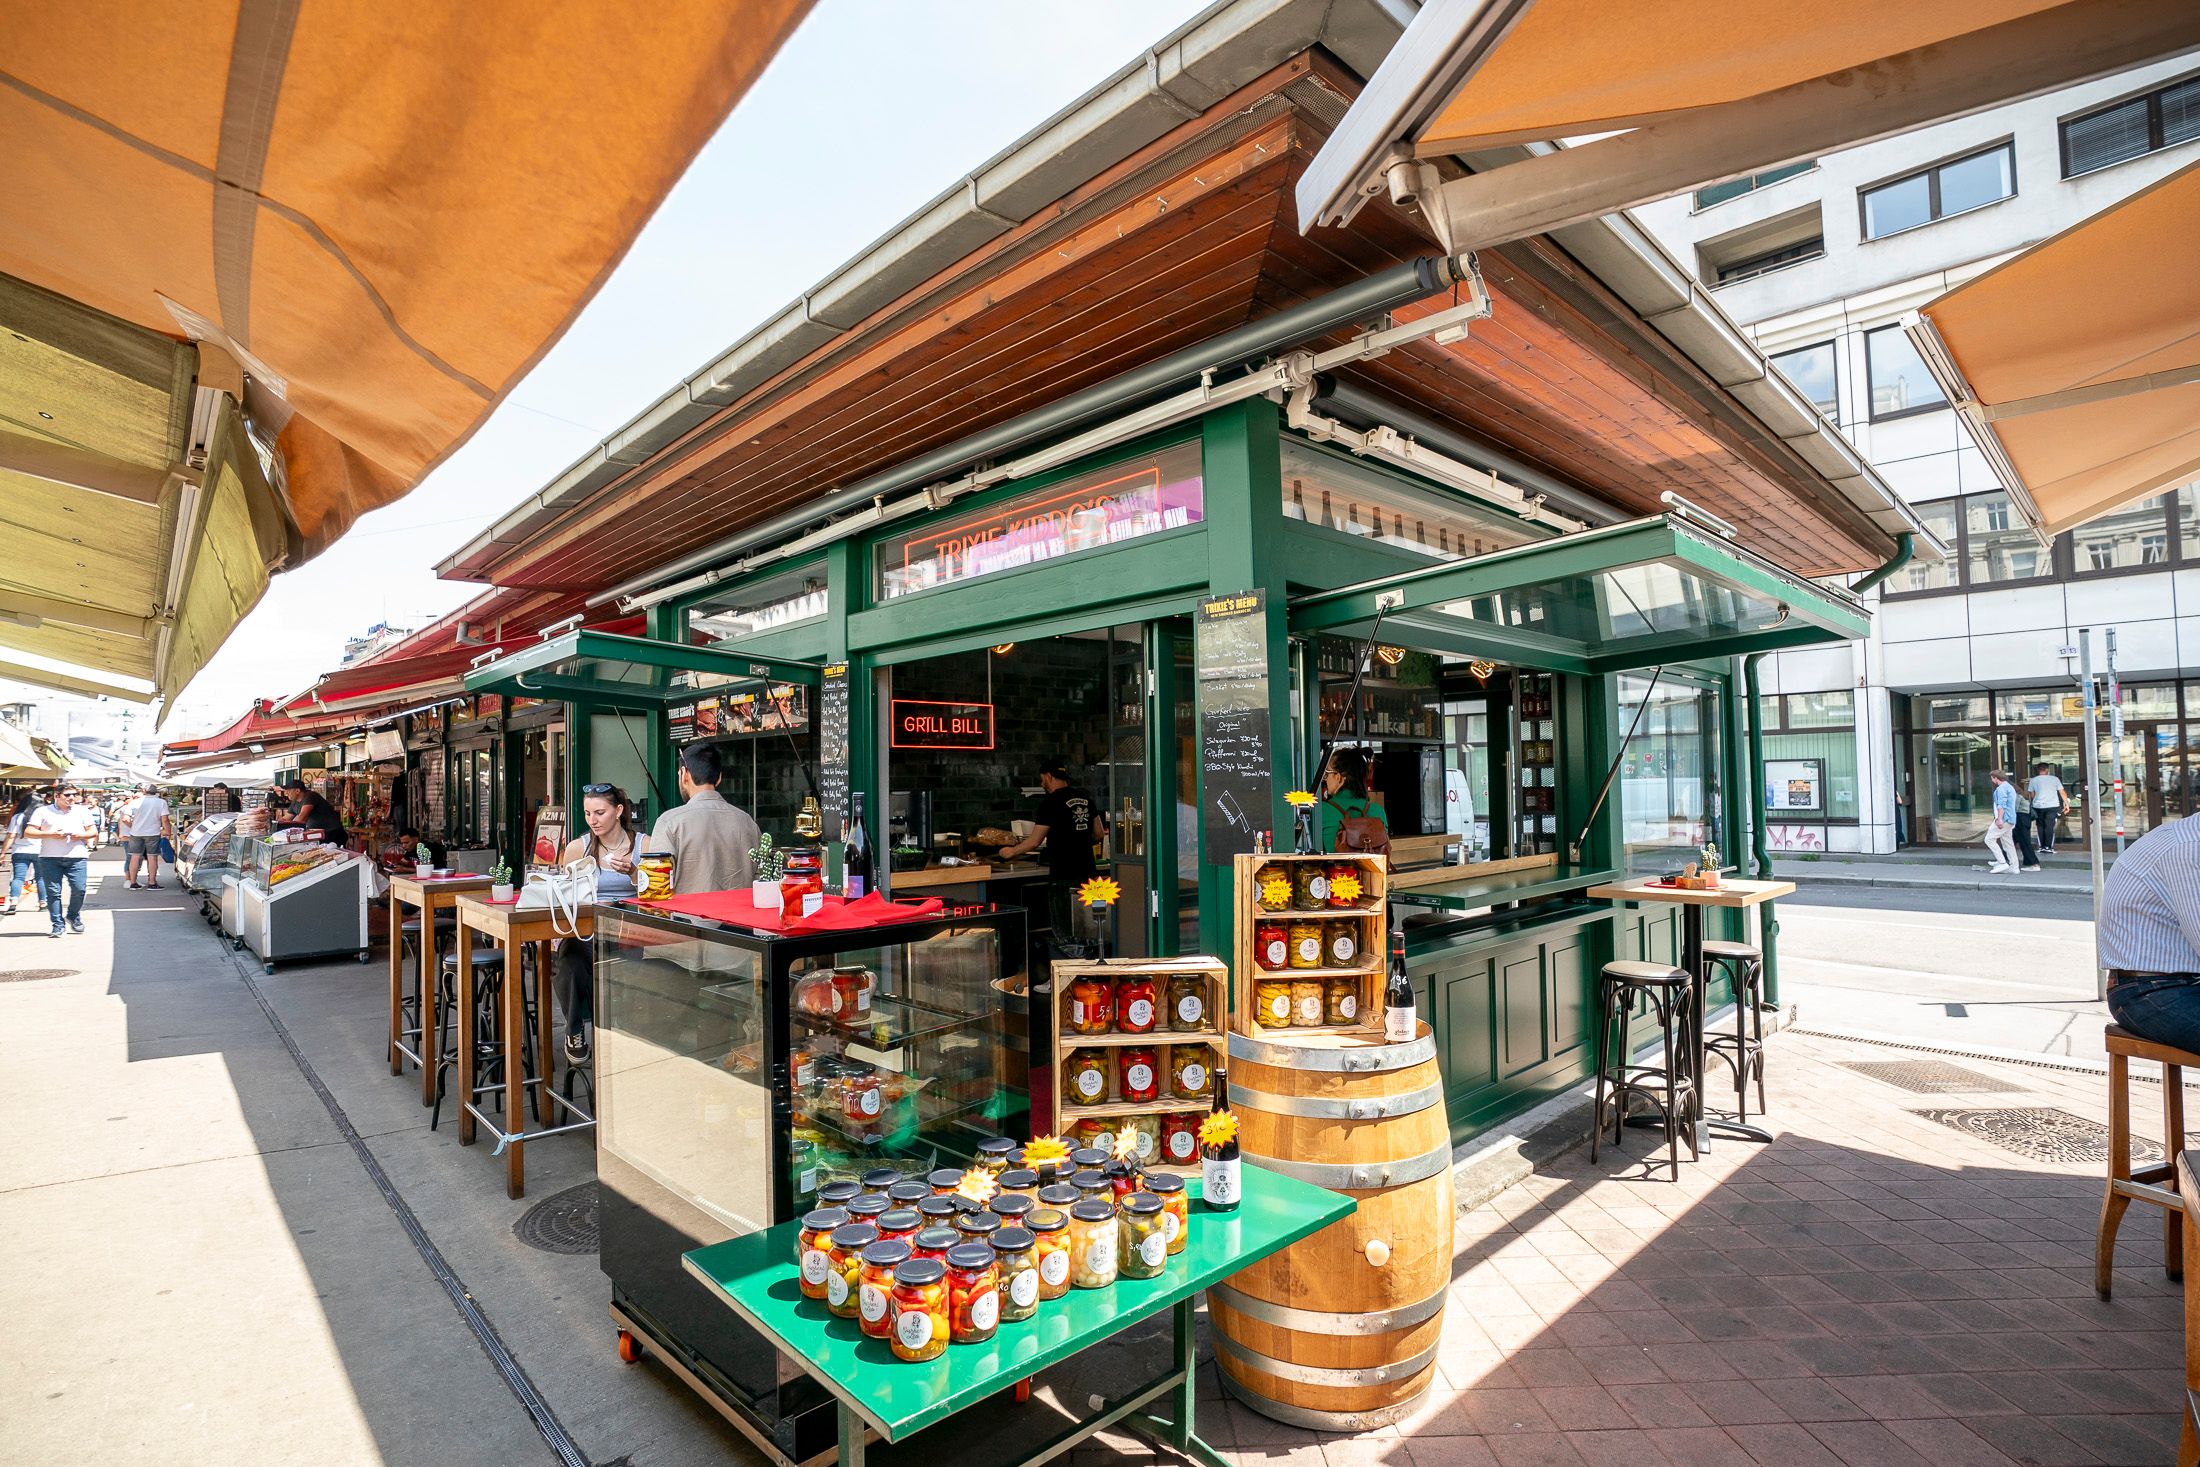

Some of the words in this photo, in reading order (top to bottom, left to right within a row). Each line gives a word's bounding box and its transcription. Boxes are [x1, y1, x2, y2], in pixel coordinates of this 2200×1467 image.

[935, 526, 1001, 568] TRIXIE
[1007, 494, 1113, 547] KIDDO'S
[1204, 598, 1235, 614] TRIXIE'S
[1235, 596, 1258, 610] MENU
[904, 716, 948, 733] GRILL
[951, 718, 983, 734] BILL
